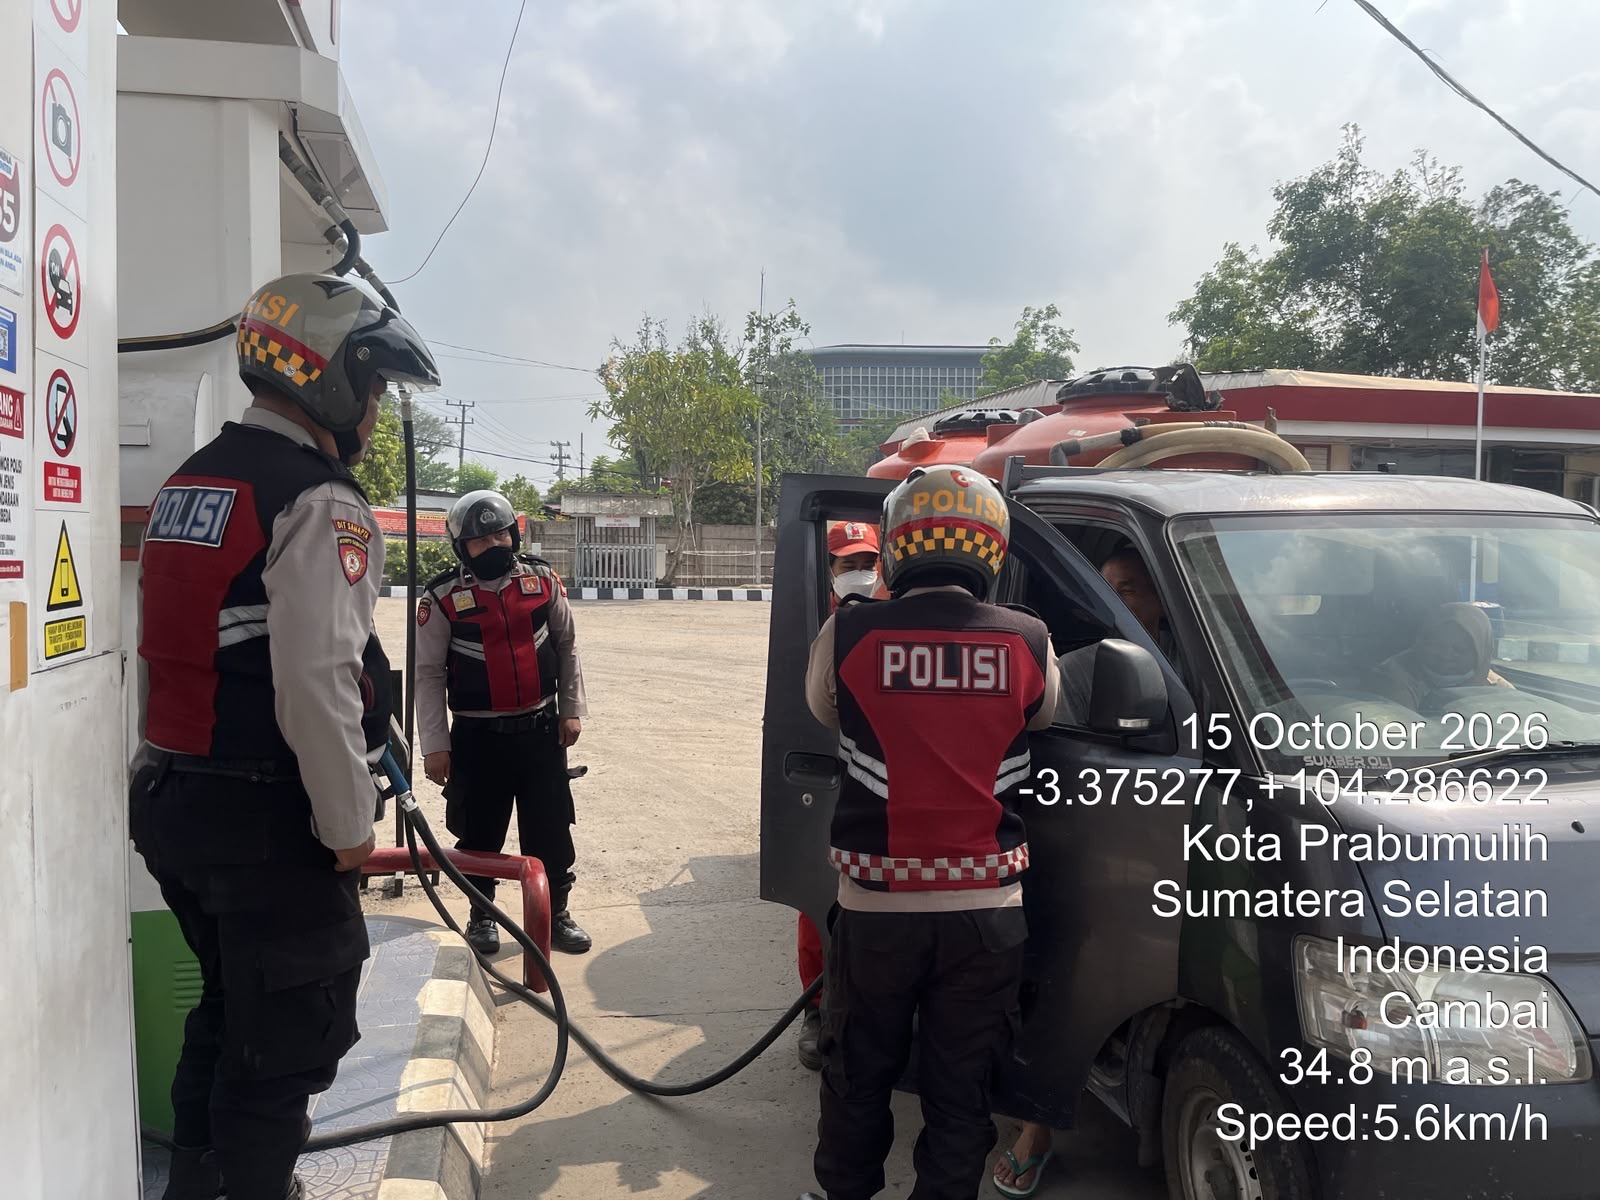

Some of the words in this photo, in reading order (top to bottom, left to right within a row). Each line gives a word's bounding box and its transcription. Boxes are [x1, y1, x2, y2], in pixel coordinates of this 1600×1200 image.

[247, 291, 299, 327] ISI
[153, 490, 231, 540] POLISI
[913, 488, 1005, 526] POLISI
[883, 645, 1008, 690] POLISI
[1303, 755, 1366, 769] SUMBER
[1367, 756, 1392, 769] OLI
